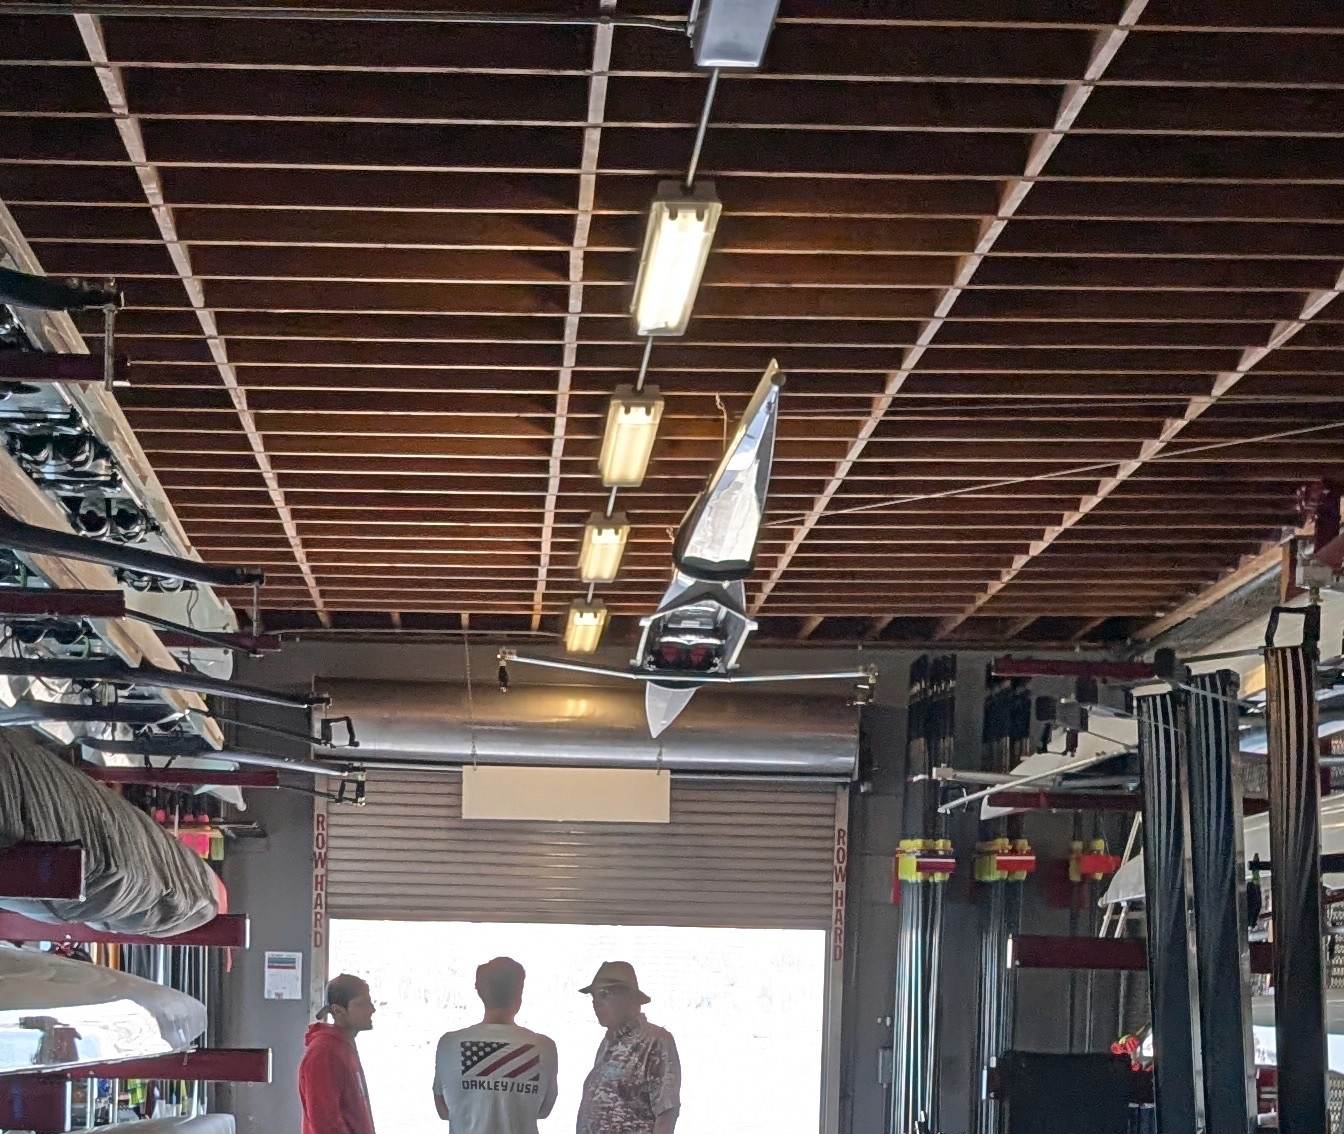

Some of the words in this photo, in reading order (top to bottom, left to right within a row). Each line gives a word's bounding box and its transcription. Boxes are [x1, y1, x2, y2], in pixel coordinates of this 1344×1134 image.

[314, 813, 327, 870] ROW
[834, 828, 846, 883] ROW
[313, 874, 325, 948] HARD
[833, 889, 844, 962] HARD
